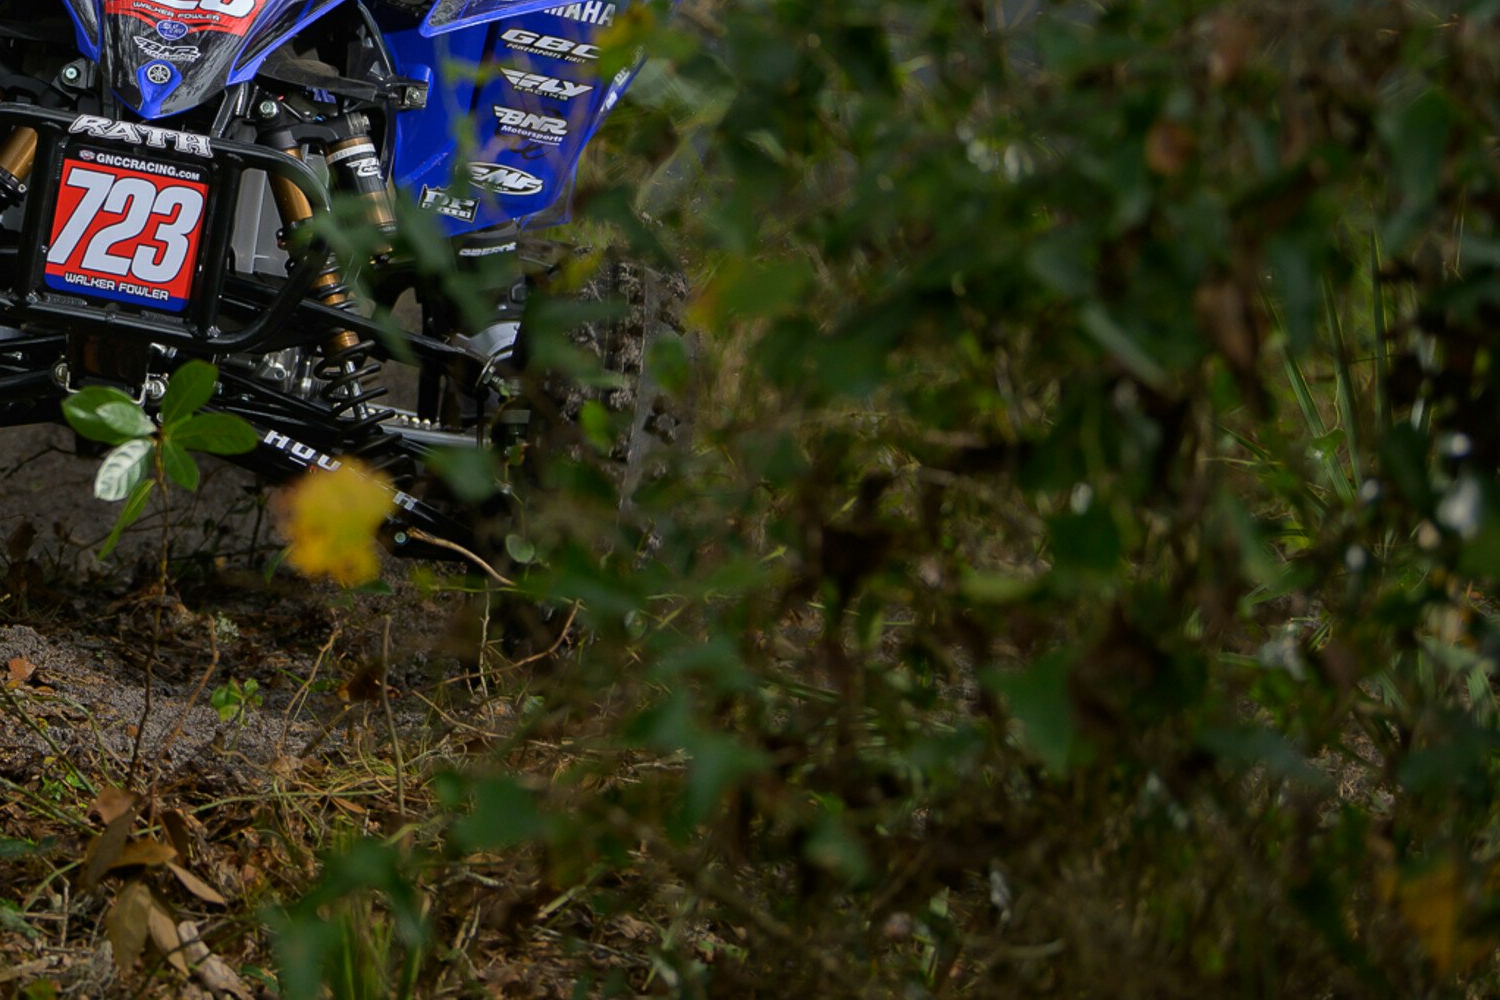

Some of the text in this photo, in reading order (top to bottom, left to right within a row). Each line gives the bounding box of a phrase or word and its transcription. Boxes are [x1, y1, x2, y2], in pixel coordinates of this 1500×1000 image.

[500, 28, 600, 59] GBC
[499, 67, 595, 98] FLY
[68, 113, 214, 158] RATH
[493, 105, 569, 135] BNR
[500, 124, 564, 143] Motorsports
[46, 167, 204, 283] 723
[64, 272, 170, 301] WALKER FOWLER
